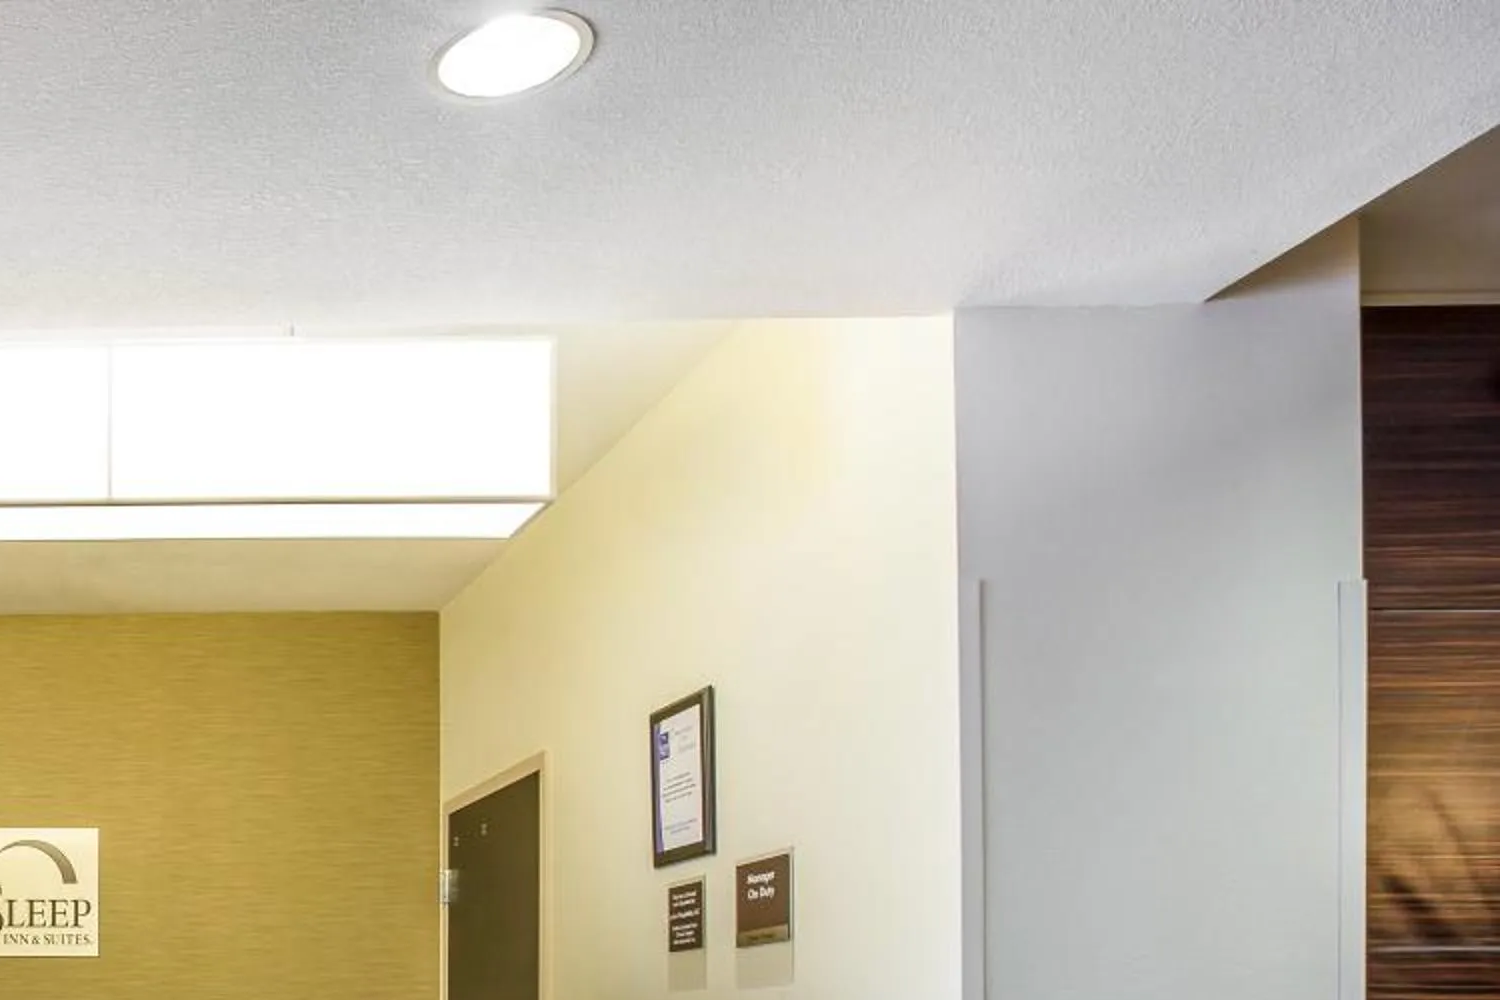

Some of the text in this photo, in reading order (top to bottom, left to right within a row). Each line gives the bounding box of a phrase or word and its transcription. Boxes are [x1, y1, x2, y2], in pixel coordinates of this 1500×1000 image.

[3, 933, 91, 945] INN & SUITES
